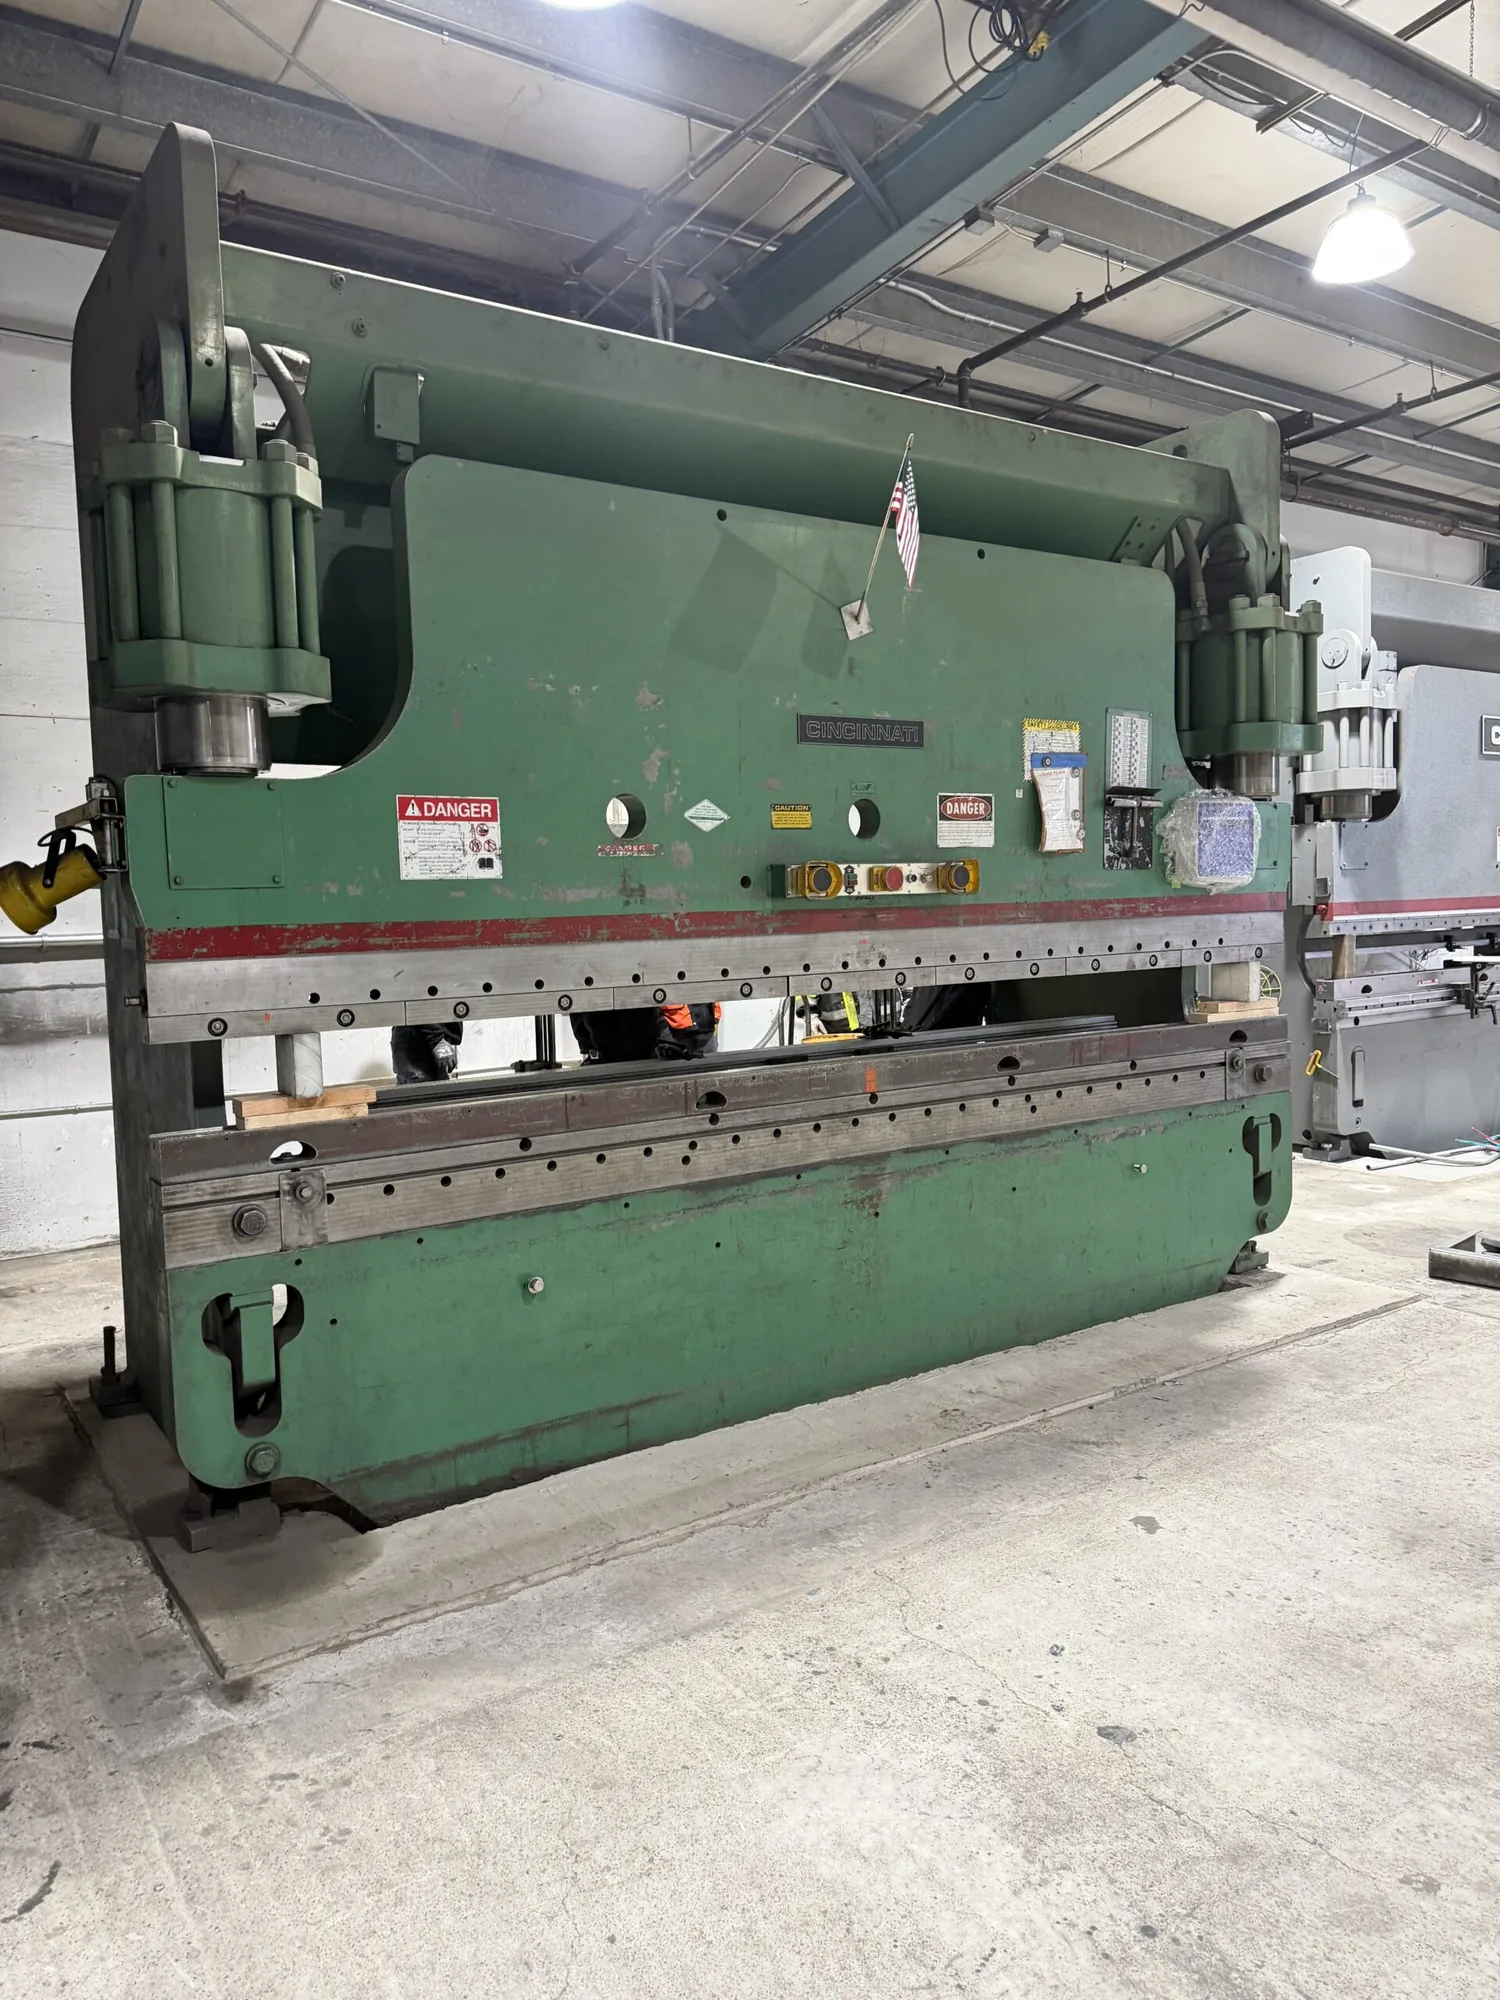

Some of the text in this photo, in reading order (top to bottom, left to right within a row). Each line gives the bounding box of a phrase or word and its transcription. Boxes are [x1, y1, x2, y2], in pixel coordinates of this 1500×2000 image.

[806, 720, 919, 743] CINCINNATI
[423, 801, 492, 818] DANGER
[946, 802, 985, 815] DANGER
